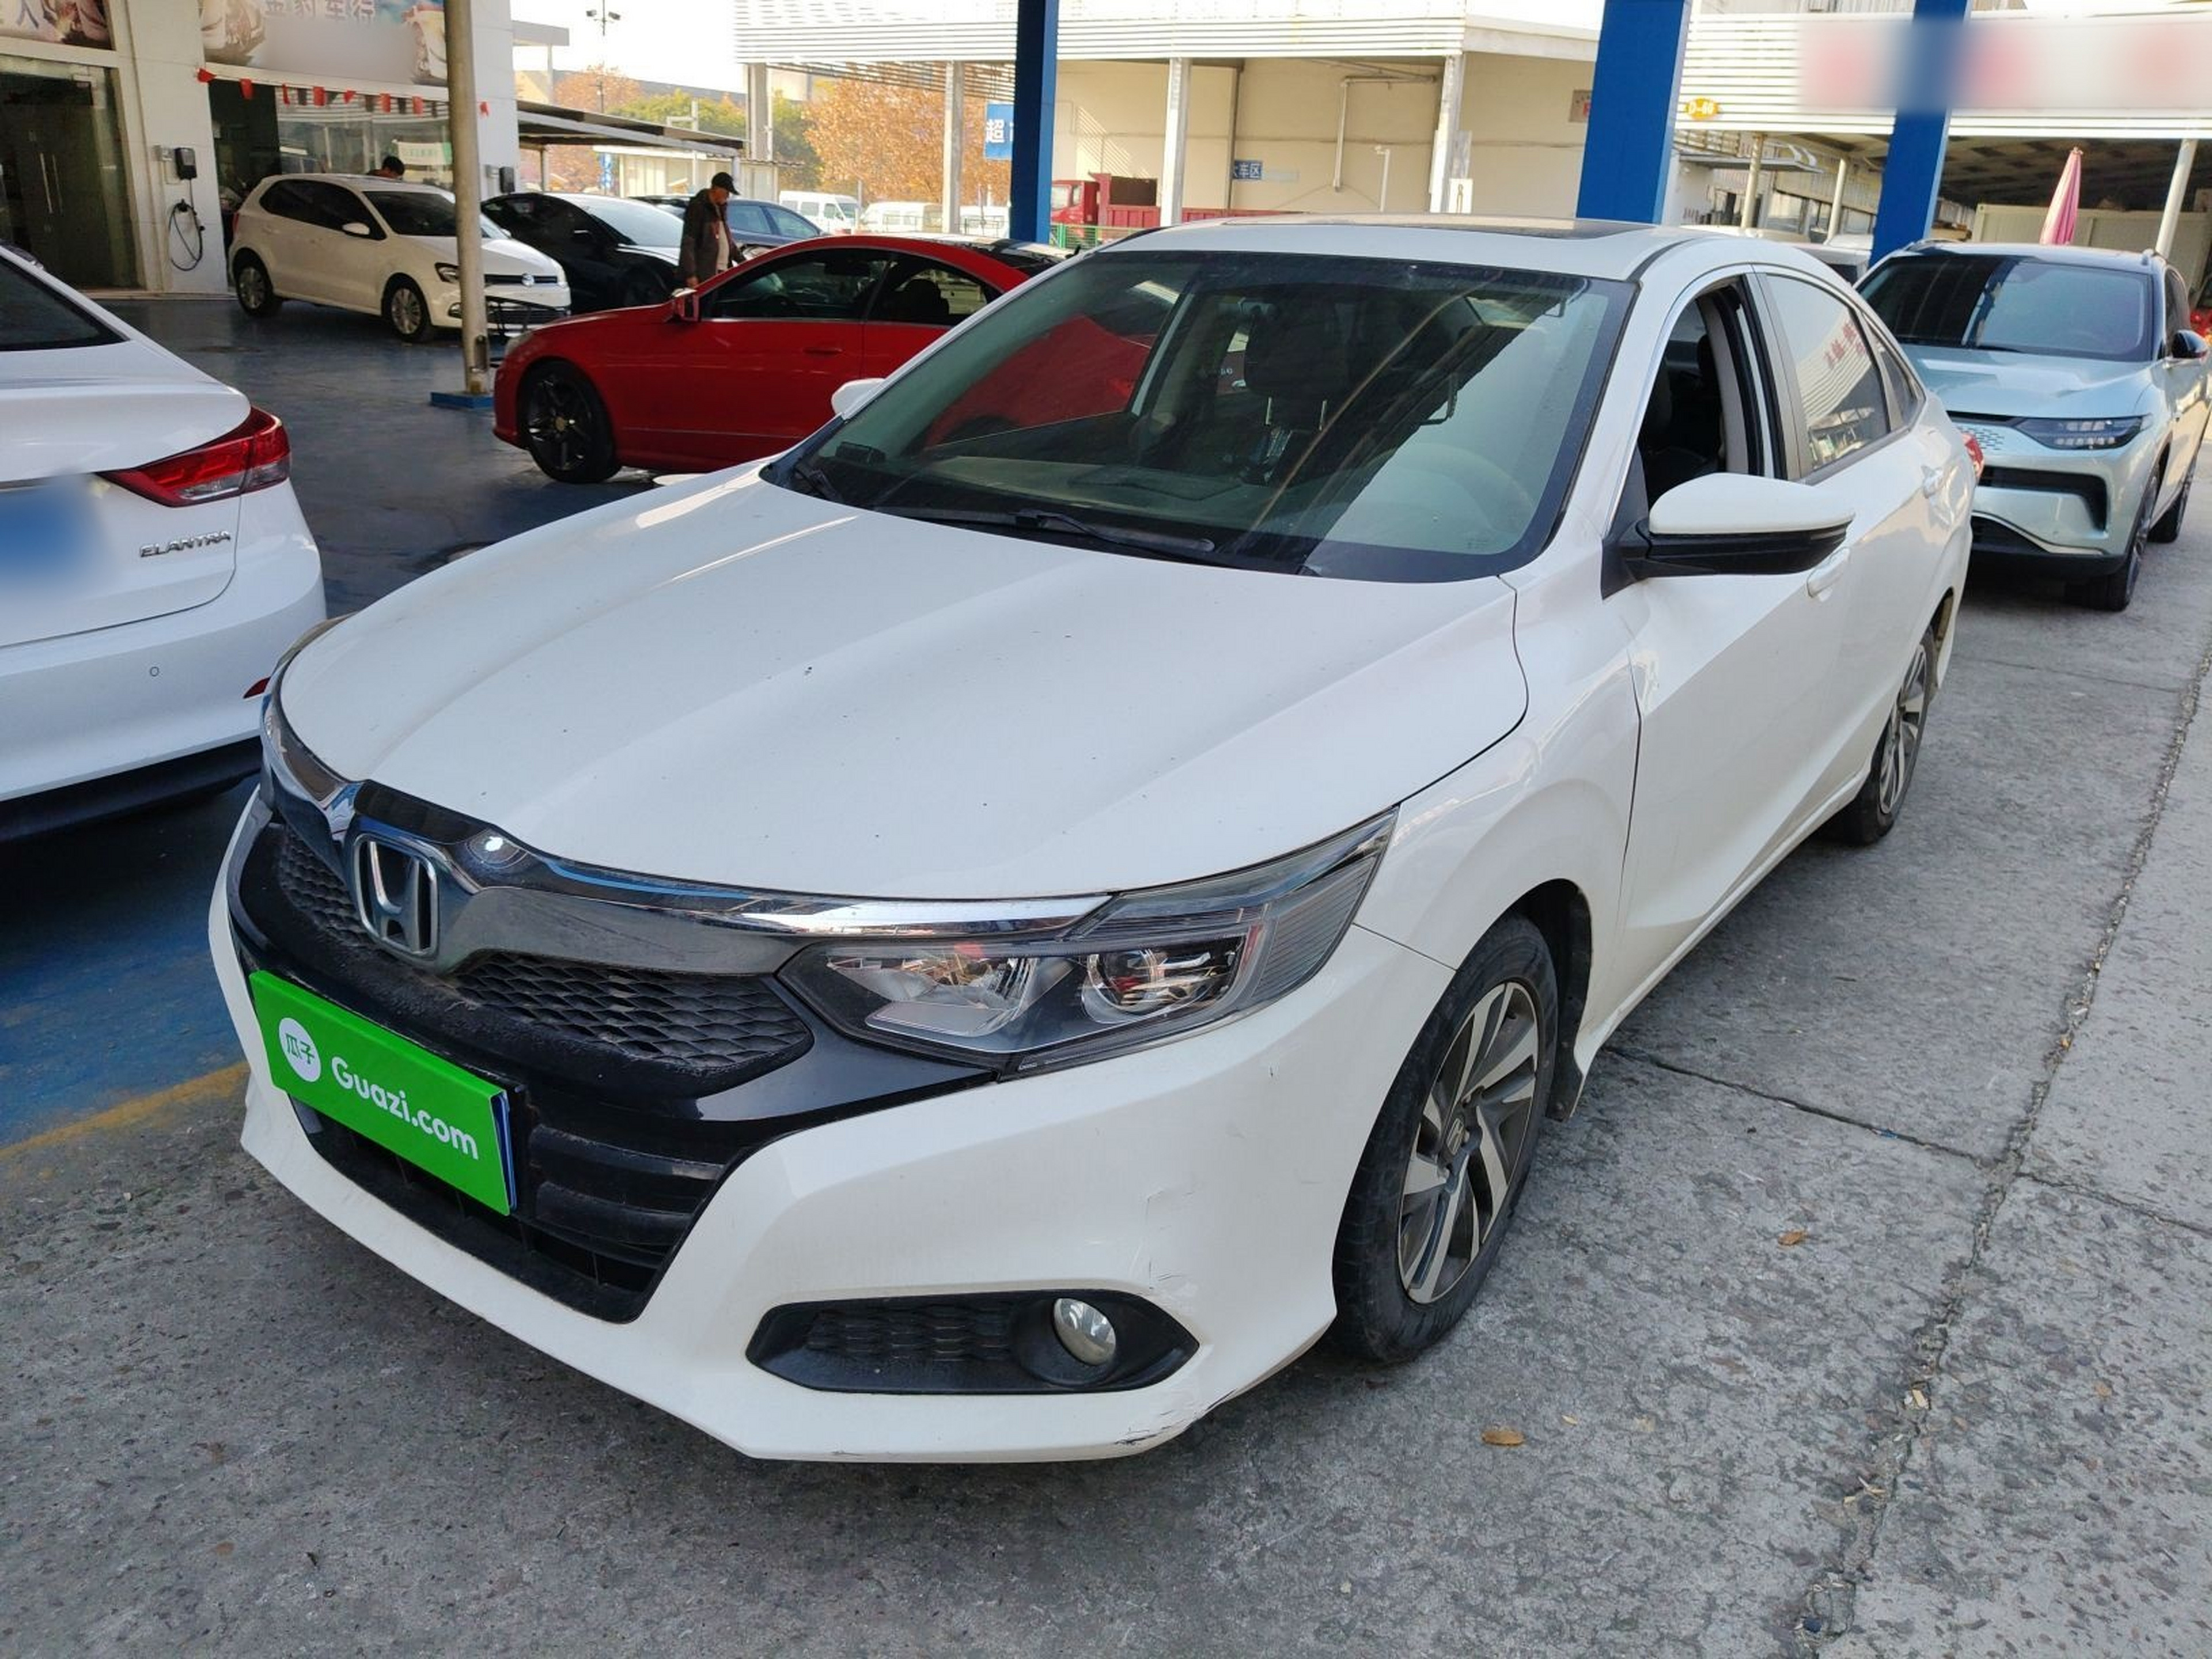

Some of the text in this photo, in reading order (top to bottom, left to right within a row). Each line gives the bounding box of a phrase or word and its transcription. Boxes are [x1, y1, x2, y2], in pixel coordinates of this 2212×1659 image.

[986, 119, 1014, 143] 超
[140, 531, 231, 557] ELANTRA
[285, 1033, 316, 1065] 瓜子
[331, 1056, 479, 1160] Guazi.com
